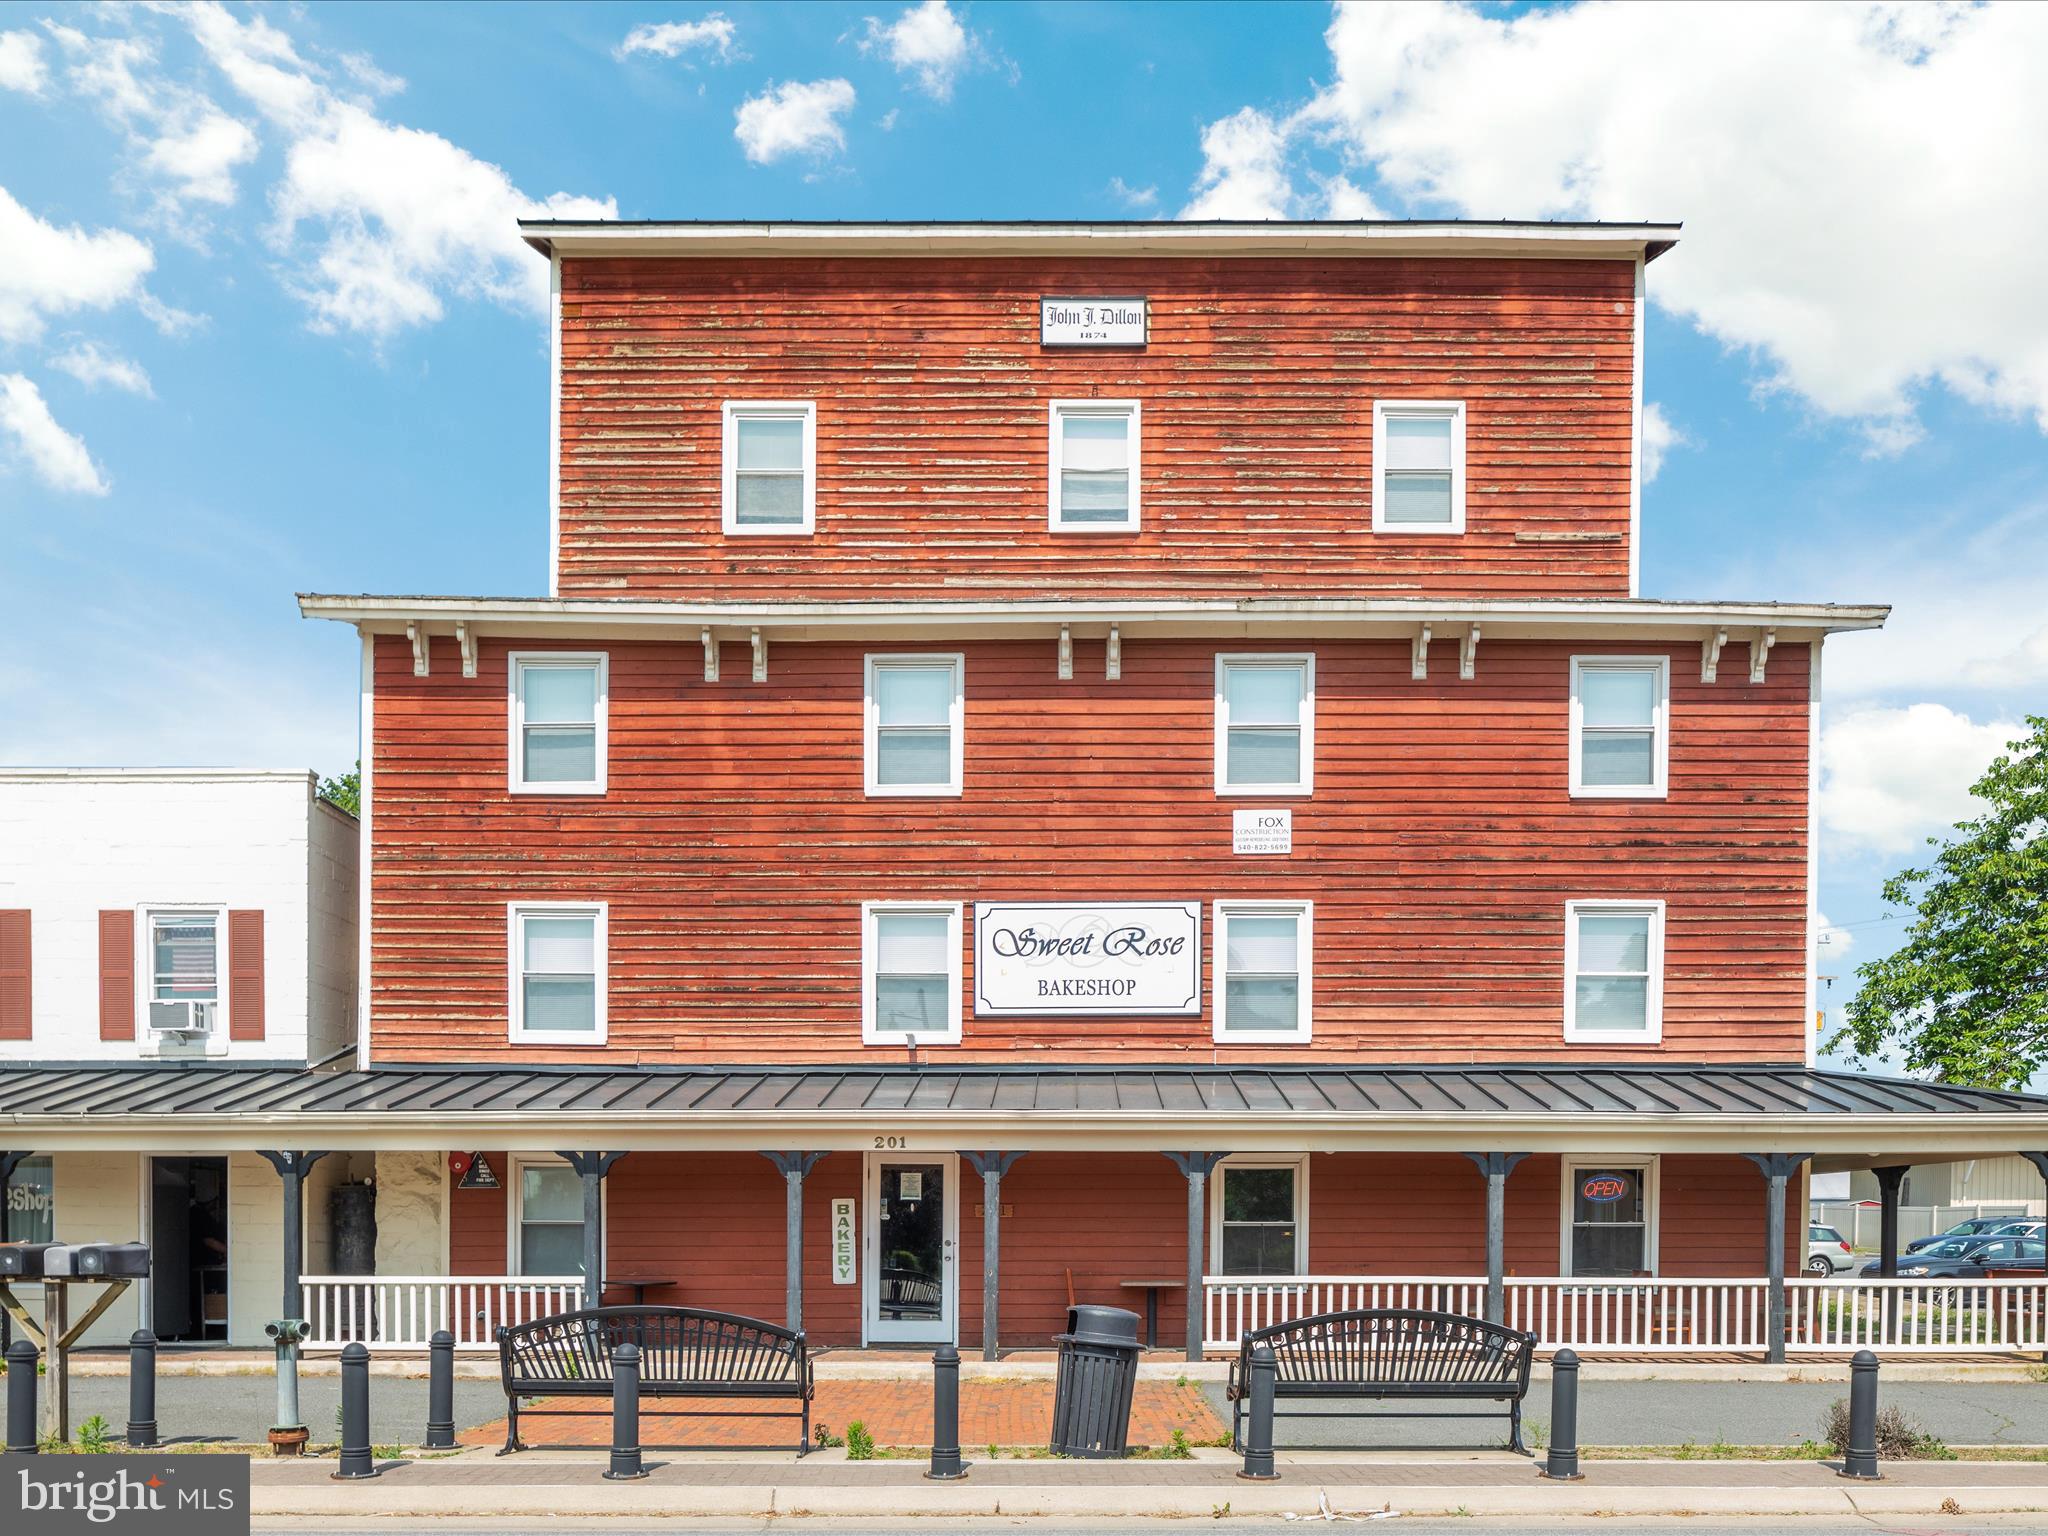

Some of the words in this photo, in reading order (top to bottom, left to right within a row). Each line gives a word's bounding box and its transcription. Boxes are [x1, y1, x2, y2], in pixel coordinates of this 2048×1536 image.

[1046, 306, 1080, 327] John
[1083, 307, 1096, 328] J.
[1100, 308, 1141, 325] Dillon
[1258, 817, 1284, 828] FOX
[992, 927, 1095, 957] Sweet
[1102, 927, 1186, 957] Rose
[1037, 979, 1137, 996] BAKESHOP
[874, 1136, 907, 1149] 201
[1584, 1181, 1625, 1197] OPEN
[836, 1204, 851, 1279] BAKERY
